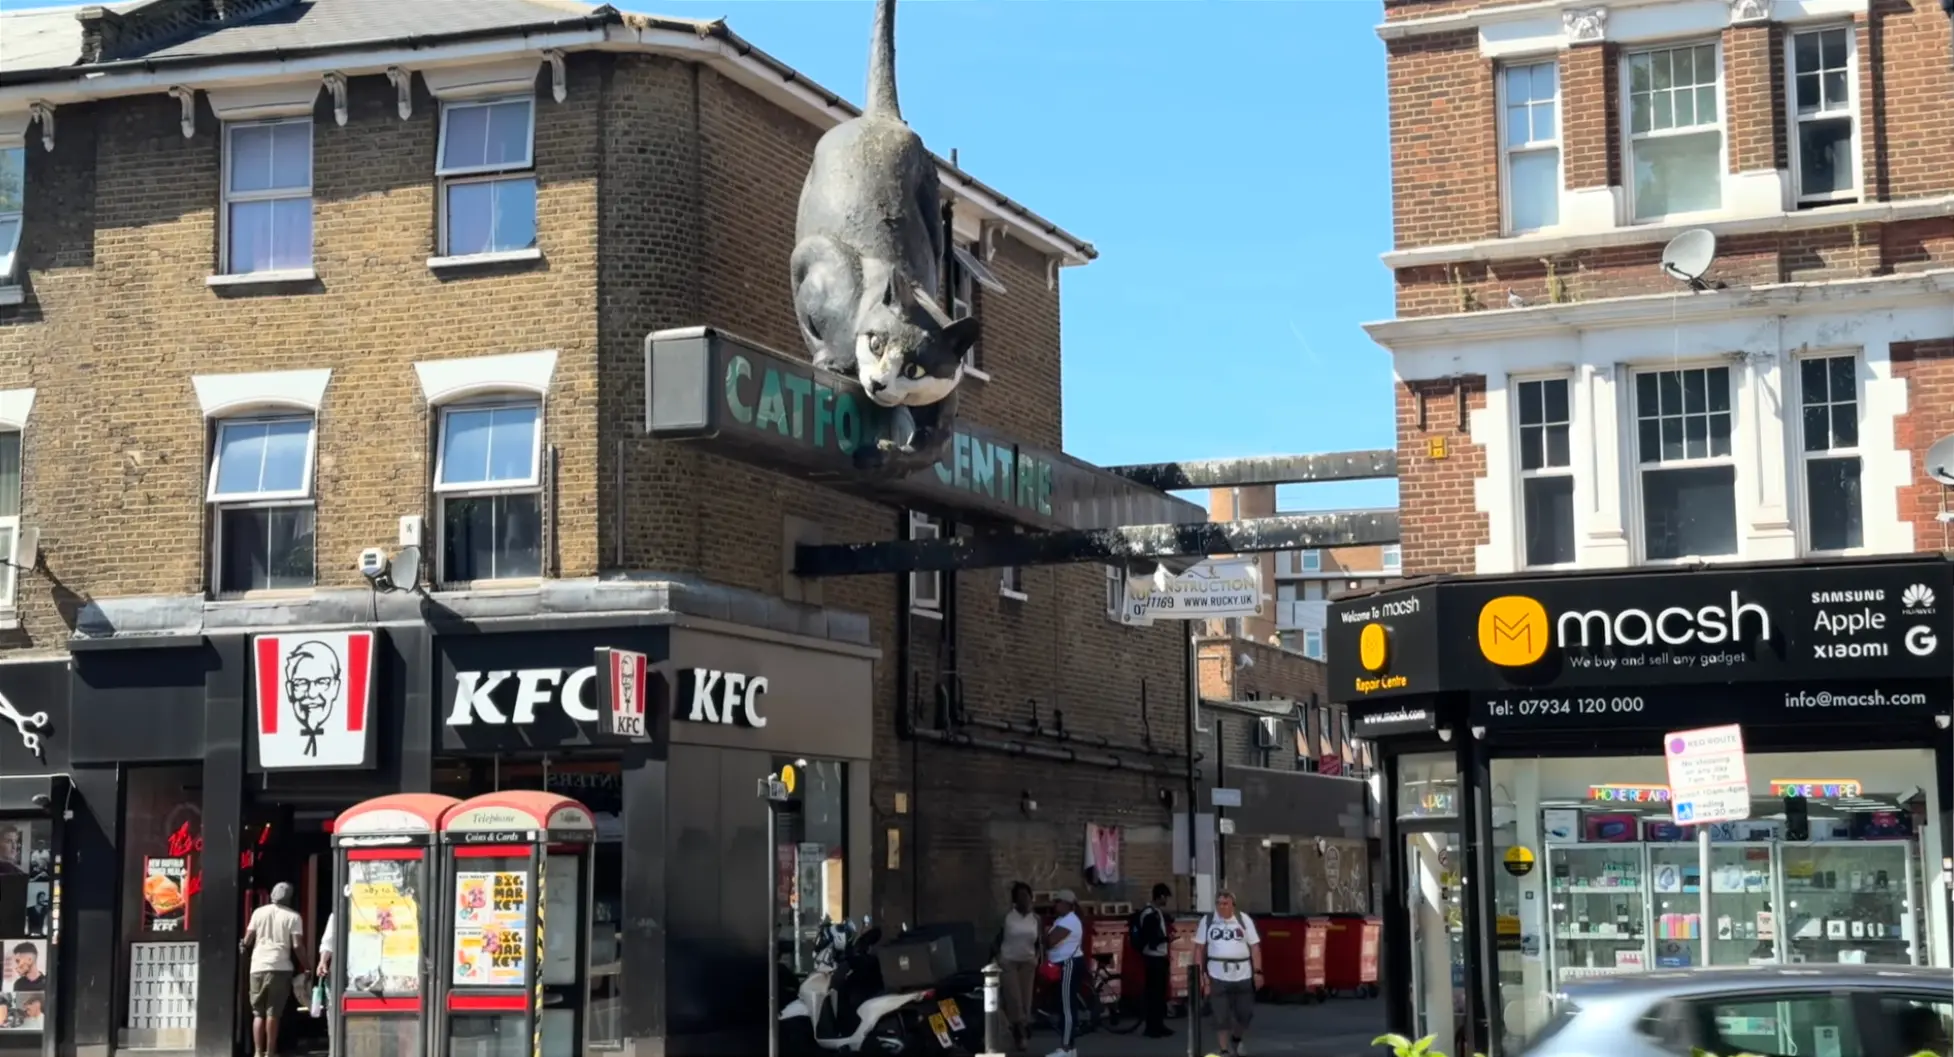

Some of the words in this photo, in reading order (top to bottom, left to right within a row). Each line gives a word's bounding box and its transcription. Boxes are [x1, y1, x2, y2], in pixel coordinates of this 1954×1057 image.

[725, 355, 862, 456] CATFO
[1150, 579, 1255, 593] NSTRUCTION
[1183, 594, 1253, 607] WWW.RUCKY.UK
[1811, 589, 1886, 604] SAMSUNG
[1341, 610, 1371, 623] Welcome
[1371, 606, 1380, 619] To
[1382, 595, 1420, 617] macsh
[1557, 590, 1770, 648] macsh
[1813, 607, 1886, 636] Apple
[1904, 625, 1938, 656] G
[1570, 656, 1591, 668] We
[1595, 653, 1618, 671] buy
[1621, 654, 1645, 667] and
[1649, 652, 1669, 665] sell
[1673, 654, 1696, 669] any
[1700, 650, 1746, 669] gadget
[1355, 677, 1380, 695] Repair
[1381, 675, 1407, 689] Centre
[446, 665, 599, 726] KFC
[689, 667, 769, 728] KFC
[1785, 689, 1926, 707] info@macsh.com
[1364, 705, 1426, 724] www.macsh.com
[1487, 701, 1514, 716] Tel:
[1519, 699, 1571, 715] 07934
[1577, 698, 1607, 714] 120
[1611, 697, 1644, 713] 000
[617, 716, 641, 734] KFC
[472, 812, 516, 825] Telephone
[465, 831, 487, 843] Coins
[487, 832, 494, 841] &
[496, 831, 519, 842] Cards
[494, 887, 523, 899] MAR
[494, 899, 524, 911] KET
[152, 922, 178, 932] KFC
[498, 931, 522, 942] IG
[492, 956, 522, 968] KET
